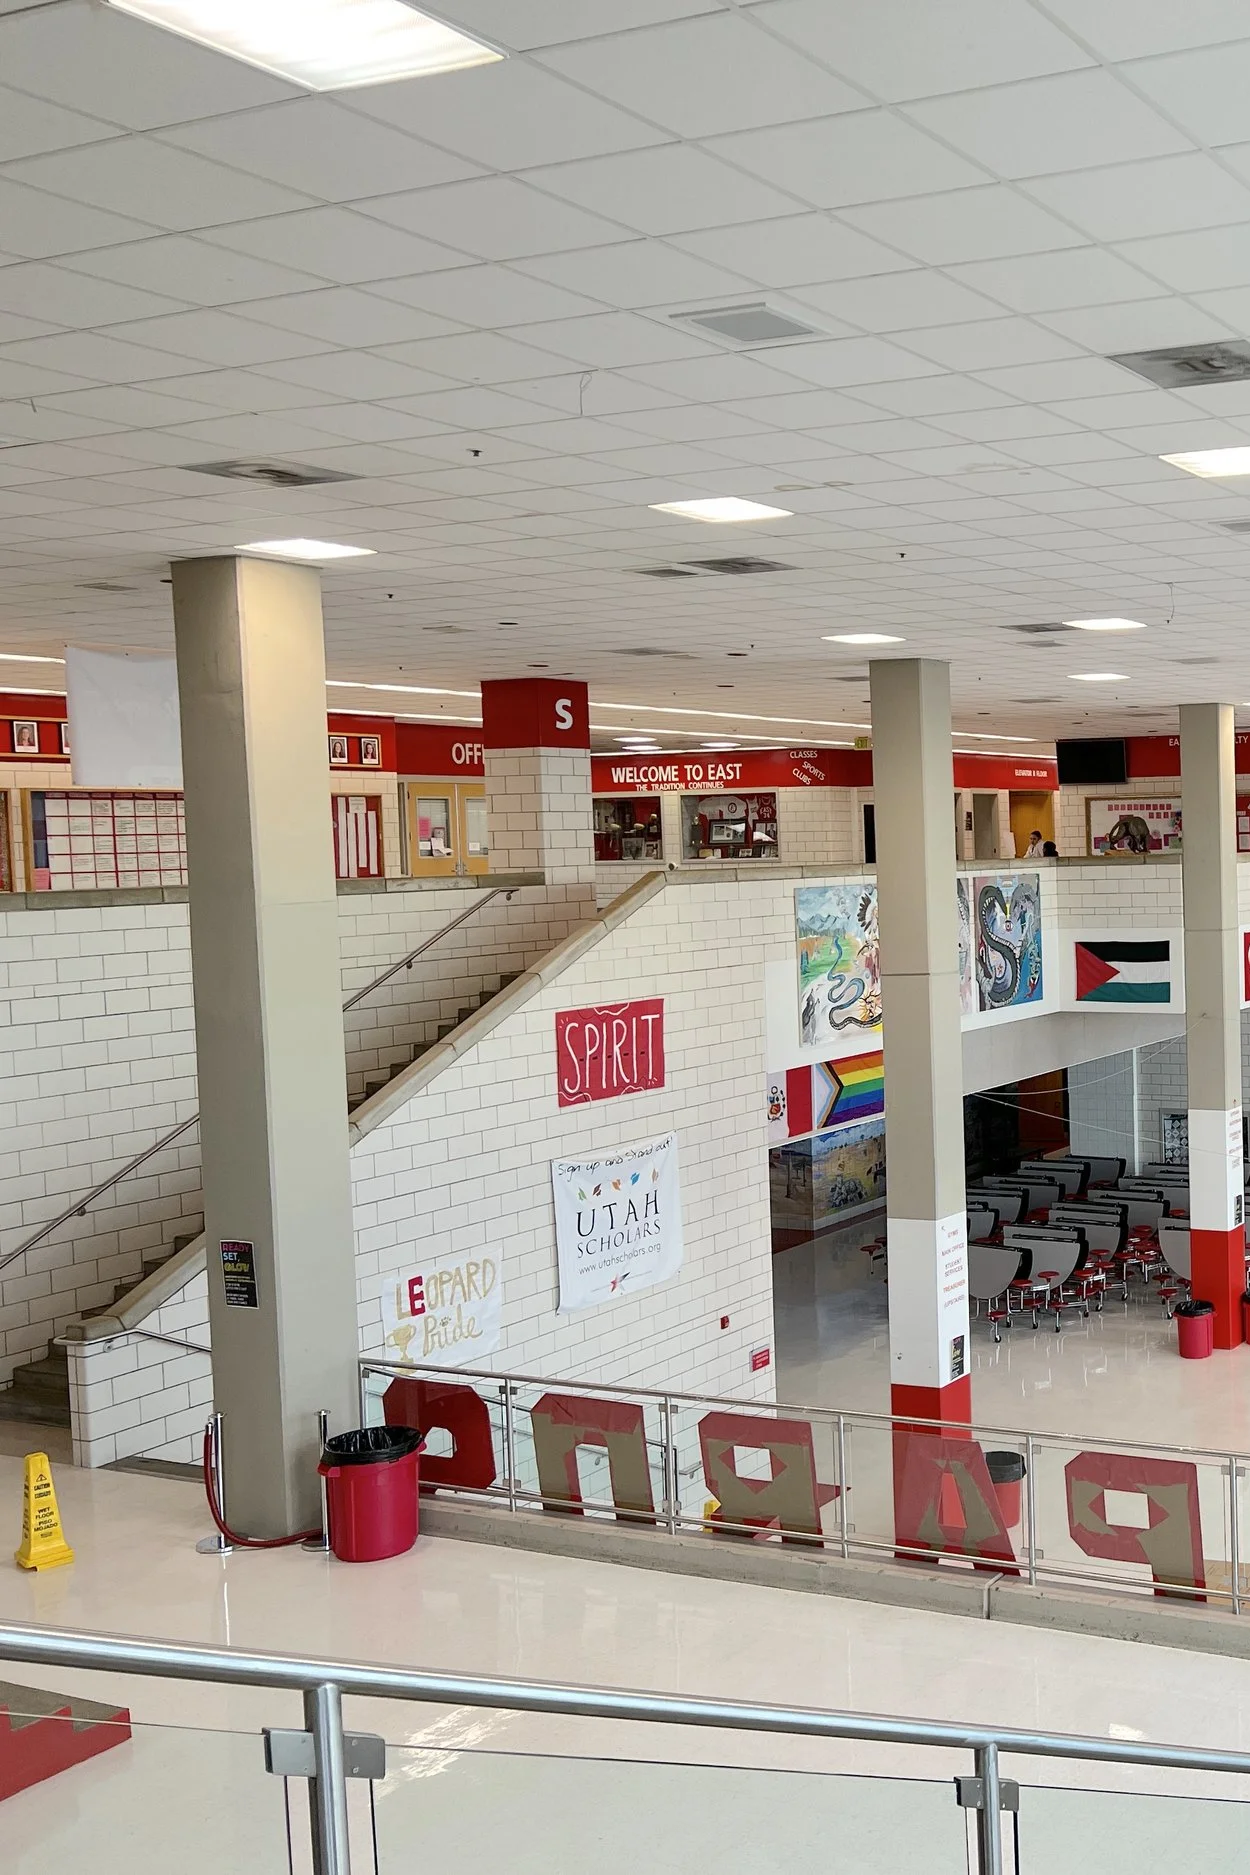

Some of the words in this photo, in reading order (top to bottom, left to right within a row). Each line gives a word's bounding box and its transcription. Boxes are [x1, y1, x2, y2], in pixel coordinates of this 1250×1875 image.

[555, 699, 573, 730] S
[790, 750, 818, 758] CLASSES
[611, 766, 679, 783] WELCOME
[684, 764, 704, 780] TO
[708, 763, 742, 780] EAST
[792, 768, 812, 785] CLUBS
[802, 761, 826, 780] SPORTS
[636, 784, 648, 792] THE
[651, 782, 686, 791] TRADITION
[688, 781, 724, 790] CONTINUES
[565, 1014, 660, 1093] SPIRIT
[558, 1162, 581, 1182] Sign
[586, 1161, 600, 1176] up
[605, 1156, 624, 1167] and
[576, 1190, 660, 1237] UTAH
[577, 1218, 662, 1259] SCHOLARS
[578, 1242, 662, 1276] www.utahscholars.org
[396, 1258, 496, 1320] LEOPARD
[423, 1304, 483, 1357] Pride
[34, 1522, 58, 1532] MOJADO
[36, 1512, 54, 1520] FLOOR
